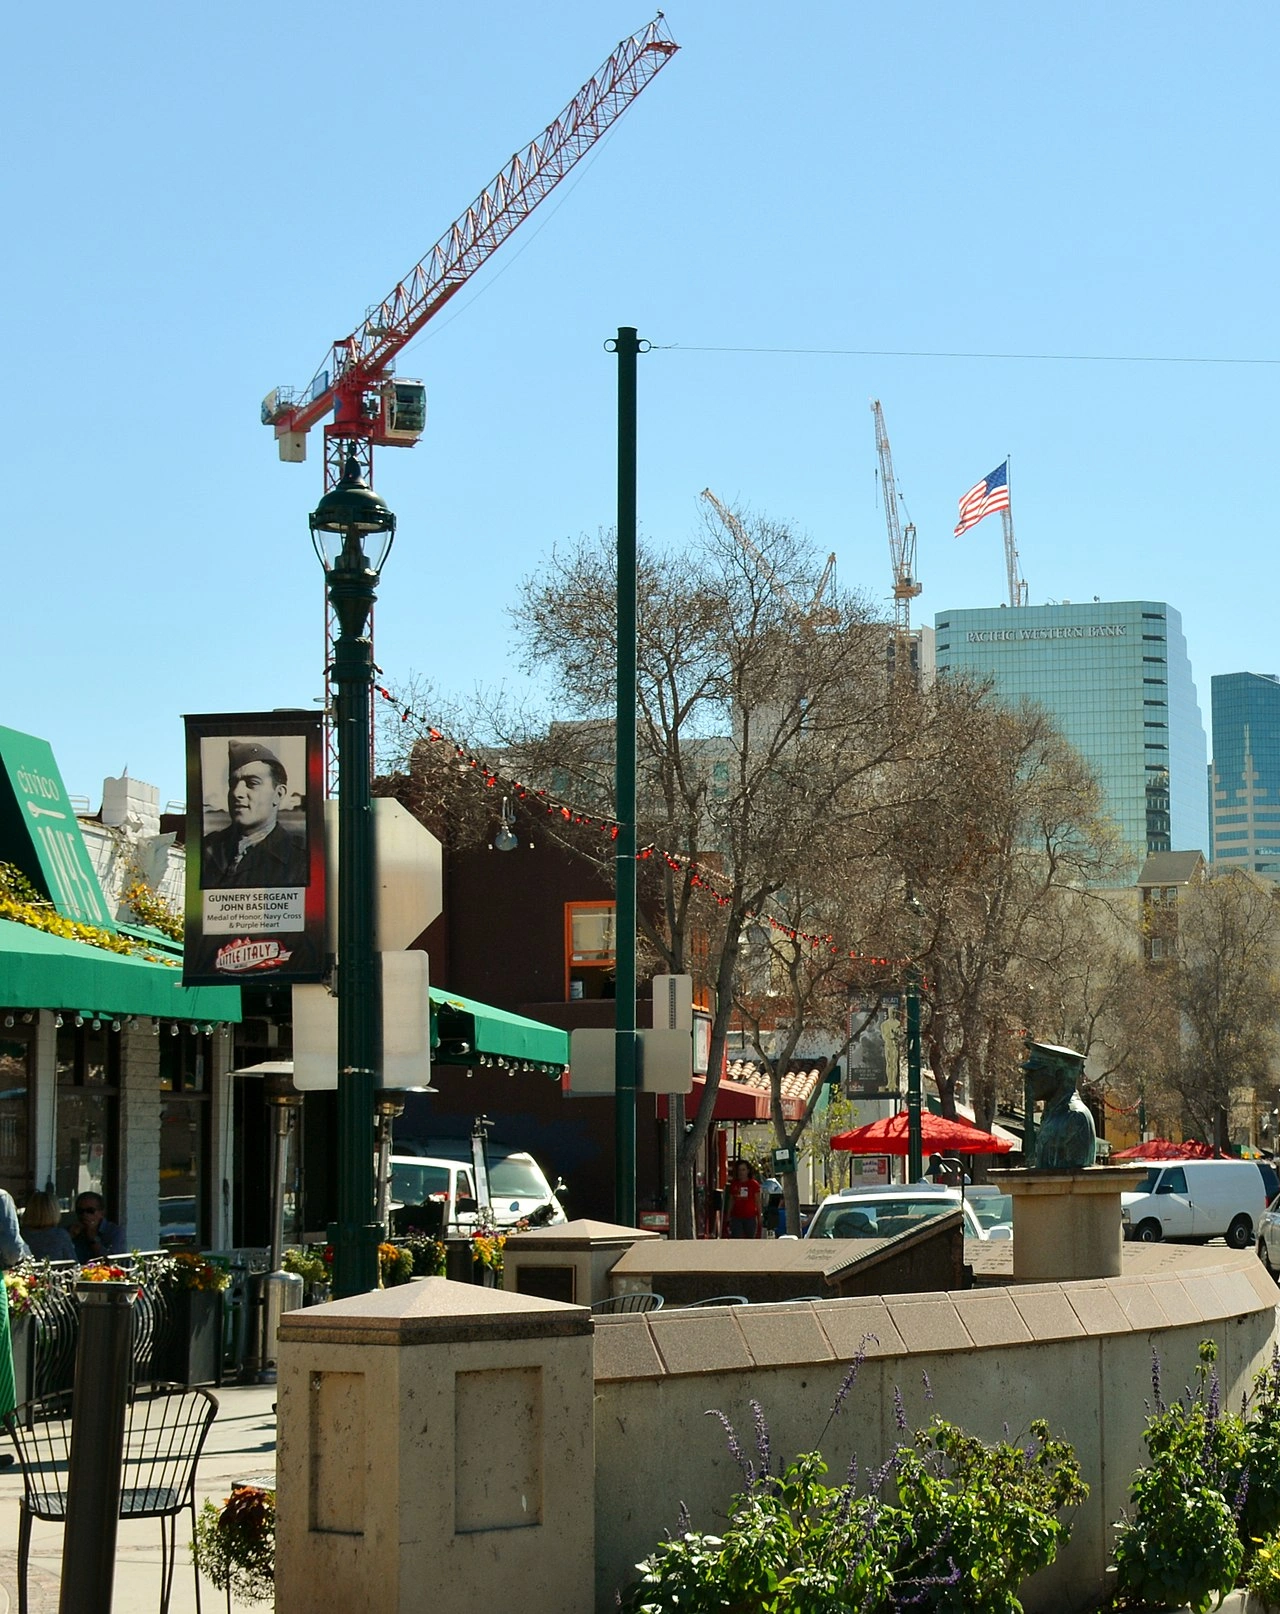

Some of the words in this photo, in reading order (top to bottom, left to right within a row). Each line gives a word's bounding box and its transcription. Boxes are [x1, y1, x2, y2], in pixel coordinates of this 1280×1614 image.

[1020, 626, 1083, 640] WESTERN
[1088, 625, 1127, 637] BANK
[17, 764, 60, 801] civico
[208, 893, 251, 902] GUNNERY
[253, 892, 299, 901] SERGEANT
[220, 903, 244, 912] JOHN
[246, 902, 289, 911] BASILONE
[219, 948, 241, 966] LITTLE
[243, 944, 271, 963] ITALY
